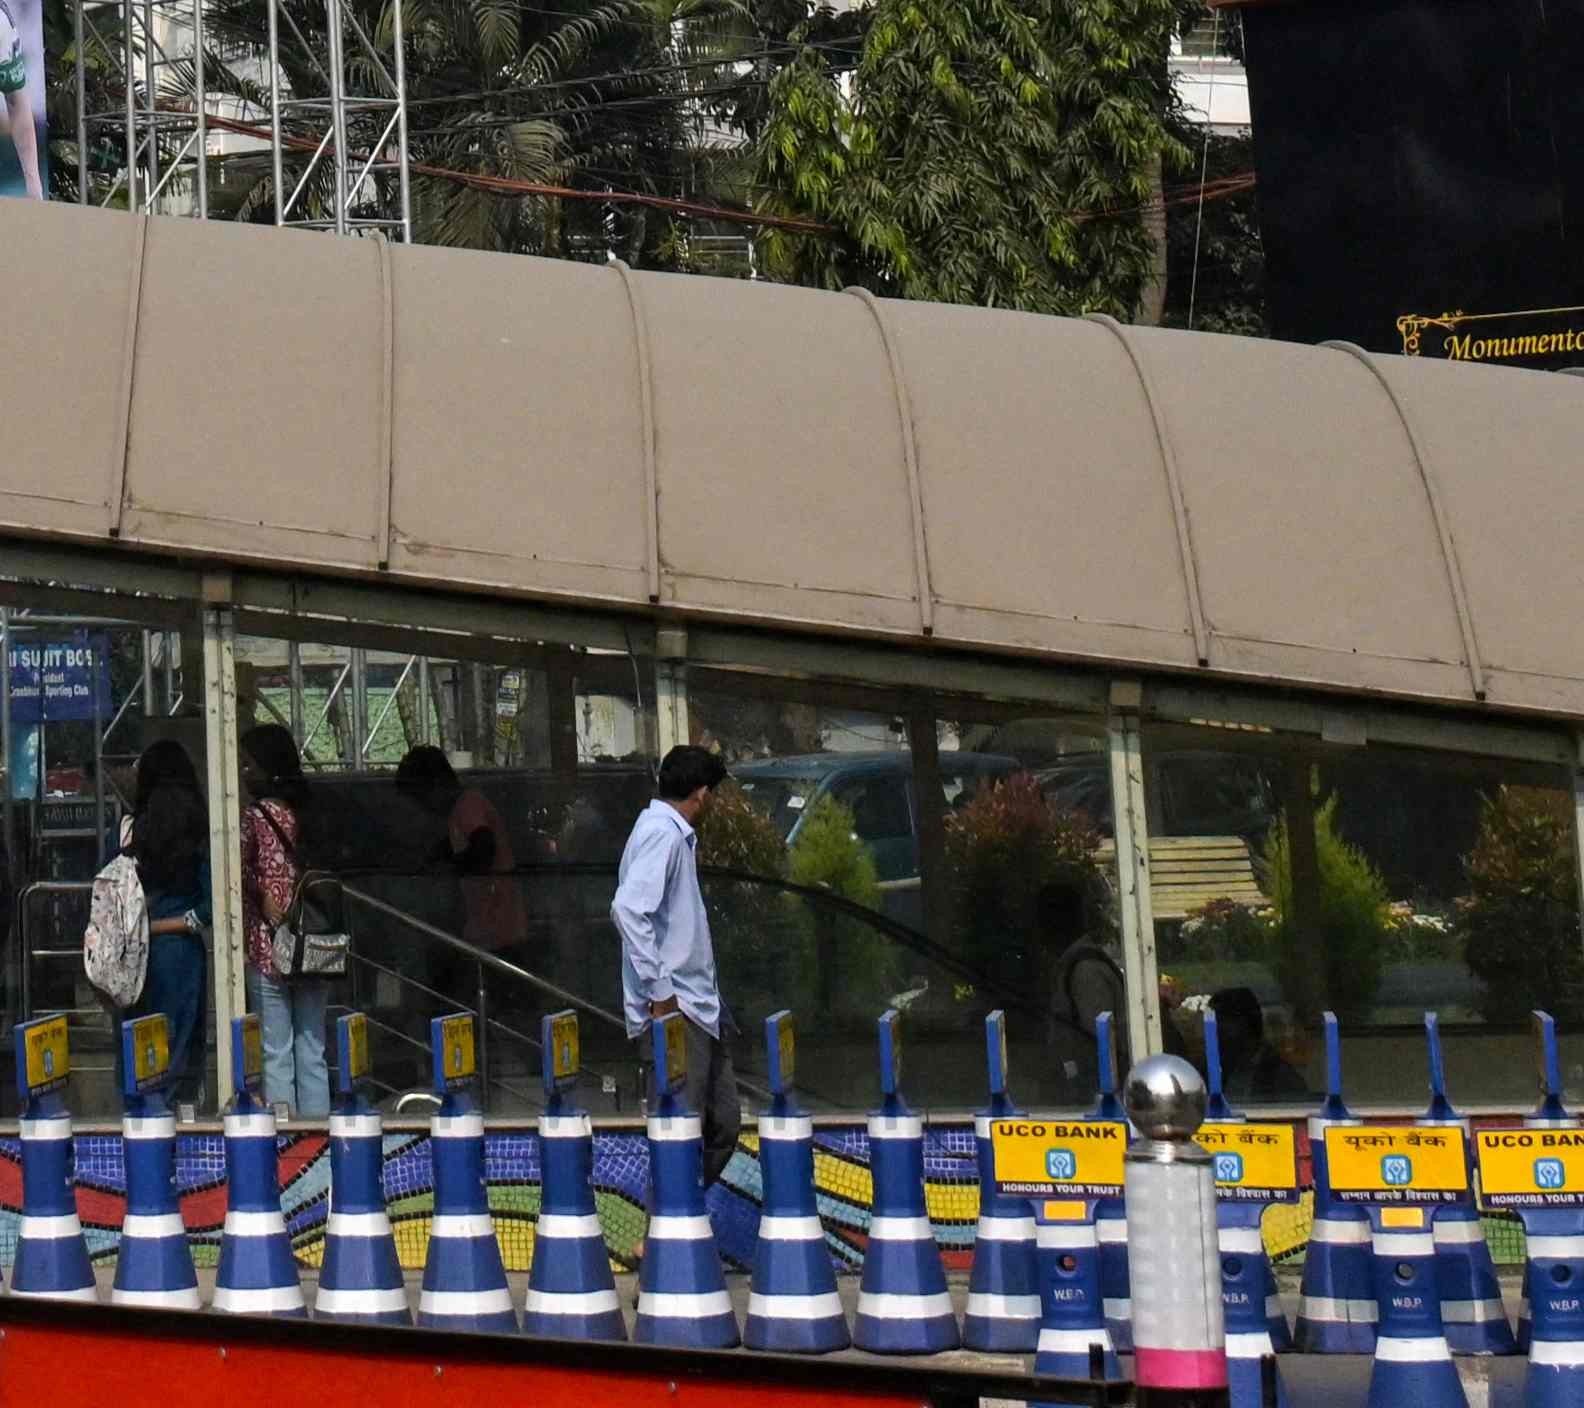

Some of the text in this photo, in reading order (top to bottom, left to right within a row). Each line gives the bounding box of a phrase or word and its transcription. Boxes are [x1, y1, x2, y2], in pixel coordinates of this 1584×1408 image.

[999, 1124, 1118, 1139] UCO BANK
[1344, 1131, 1447, 1152] यूको बैंक
[1484, 1134, 1534, 1148] UCO
[1002, 1183, 1121, 1195] HONOURS YOUR TRUST
